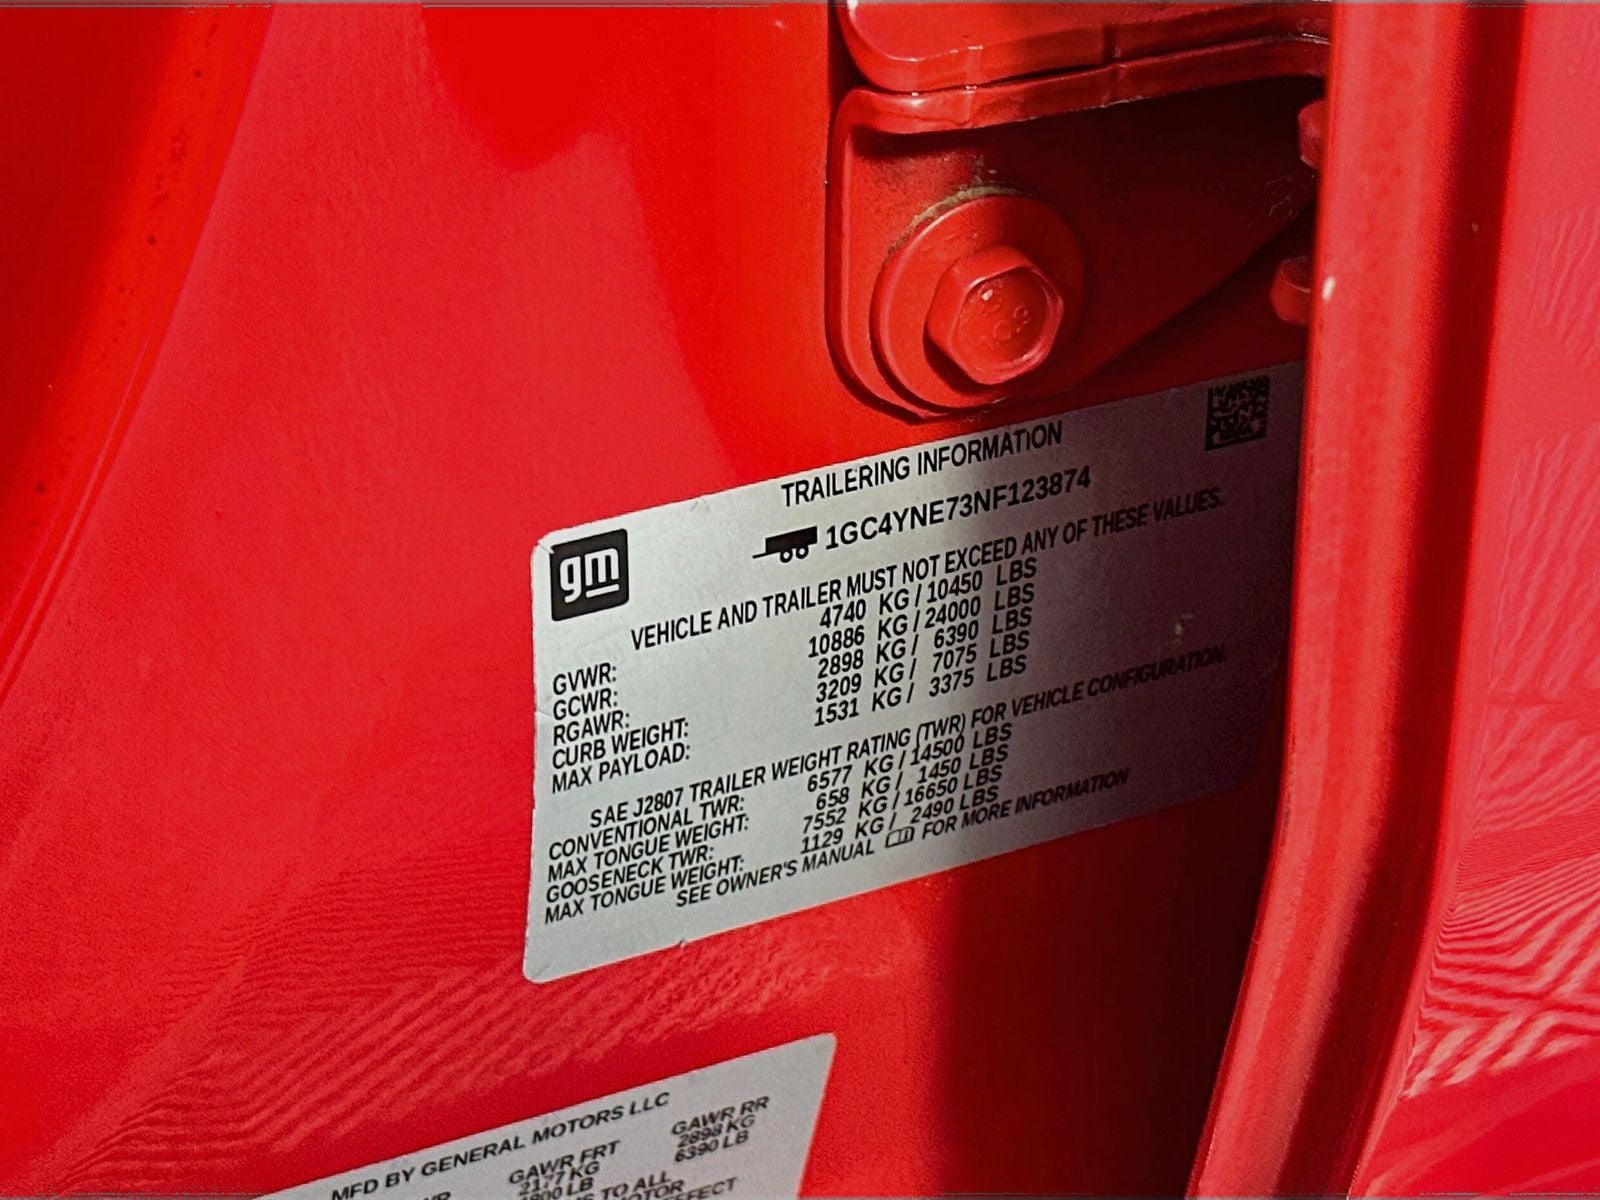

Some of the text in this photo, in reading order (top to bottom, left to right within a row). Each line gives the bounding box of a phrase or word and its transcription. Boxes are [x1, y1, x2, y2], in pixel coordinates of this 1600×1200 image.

[781, 420, 1062, 507] TRAILERING INFORMATION
[826, 465, 1091, 550] 1GC4YNE73NF123874
[553, 662, 616, 695] GVWR:
[819, 599, 866, 629] 4740
[927, 570, 983, 604] 10450
[996, 557, 1037, 586] LBS
[559, 548, 620, 604] gm
[631, 487, 1223, 650] VEHICLE AND TRAILER MUST NOT EXCEED ANY OF THESE VALUES.
[552, 738, 606, 770] CURB
[611, 717, 689, 755] WEIGHT:
[816, 673, 862, 703] 3209
[933, 643, 977, 673] 7075
[989, 630, 1030, 659] LBS
[553, 688, 618, 721] GCWR:
[809, 624, 865, 658] 10886
[924, 596, 981, 629] 24000
[994, 582, 1035, 611] LBS
[553, 710, 630, 746] RGAWR:
[817, 649, 864, 679] 2898
[934, 620, 979, 649] 6390
[992, 606, 1032, 635] LBS
[552, 765, 592, 794] MAX
[599, 742, 690, 782] PAYLOAD:
[814, 697, 859, 727] 1531
[929, 667, 975, 697] 3375
[986, 654, 1027, 682] LBS
[590, 646, 1226, 828] SAE J2807 TRAILER WEIGHT RATING (TWR) FOR VEHICLE CONFIGURATION.
[546, 856, 664, 903] GOOSENECK
[668, 845, 714, 870] TWR:
[803, 806, 847, 834] 7552
[903, 776, 958, 807] 16650
[963, 764, 1003, 791] LBS
[548, 856, 588, 883] MAX
[593, 833, 671, 870] TONGUE
[675, 813, 749, 848] WEIGHT:
[816, 786, 850, 811] 658
[917, 757, 962, 784] 1450
[969, 743, 1009, 770] LBS
[549, 807, 694, 860] CONVENTIONAL
[699, 794, 744, 821] TWR:
[807, 764, 853, 792] 6577
[910, 733, 965, 766] 14500
[972, 722, 1013, 749] LBS
[676, 768, 1129, 907] SEE OWNER'S MANUAL FOR MORE INFORMATION
[545, 898, 584, 924] MAX
[588, 875, 666, 911] TONGUE
[671, 854, 744, 890] WEIGHT:
[800, 827, 843, 854] 1129
[910, 797, 955, 824] 2490
[959, 785, 999, 811] LBS
[332, 1092, 670, 1200] MFD BY GENERAL MOTORS LLC
[509, 1140, 620, 1184] GAWR FRT
[569, 1161, 599, 1181] KG
[672, 1096, 769, 1135] GAWR RR
[675, 1130, 748, 1163] 6390 LB
[678, 1115, 754, 1148] 2898 KG
[520, 1186, 563, 1200] 800
[566, 1177, 593, 1196] LB
[600, 1171, 672, 1200] TO ALL
[620, 1179, 684, 1200] OTOR
